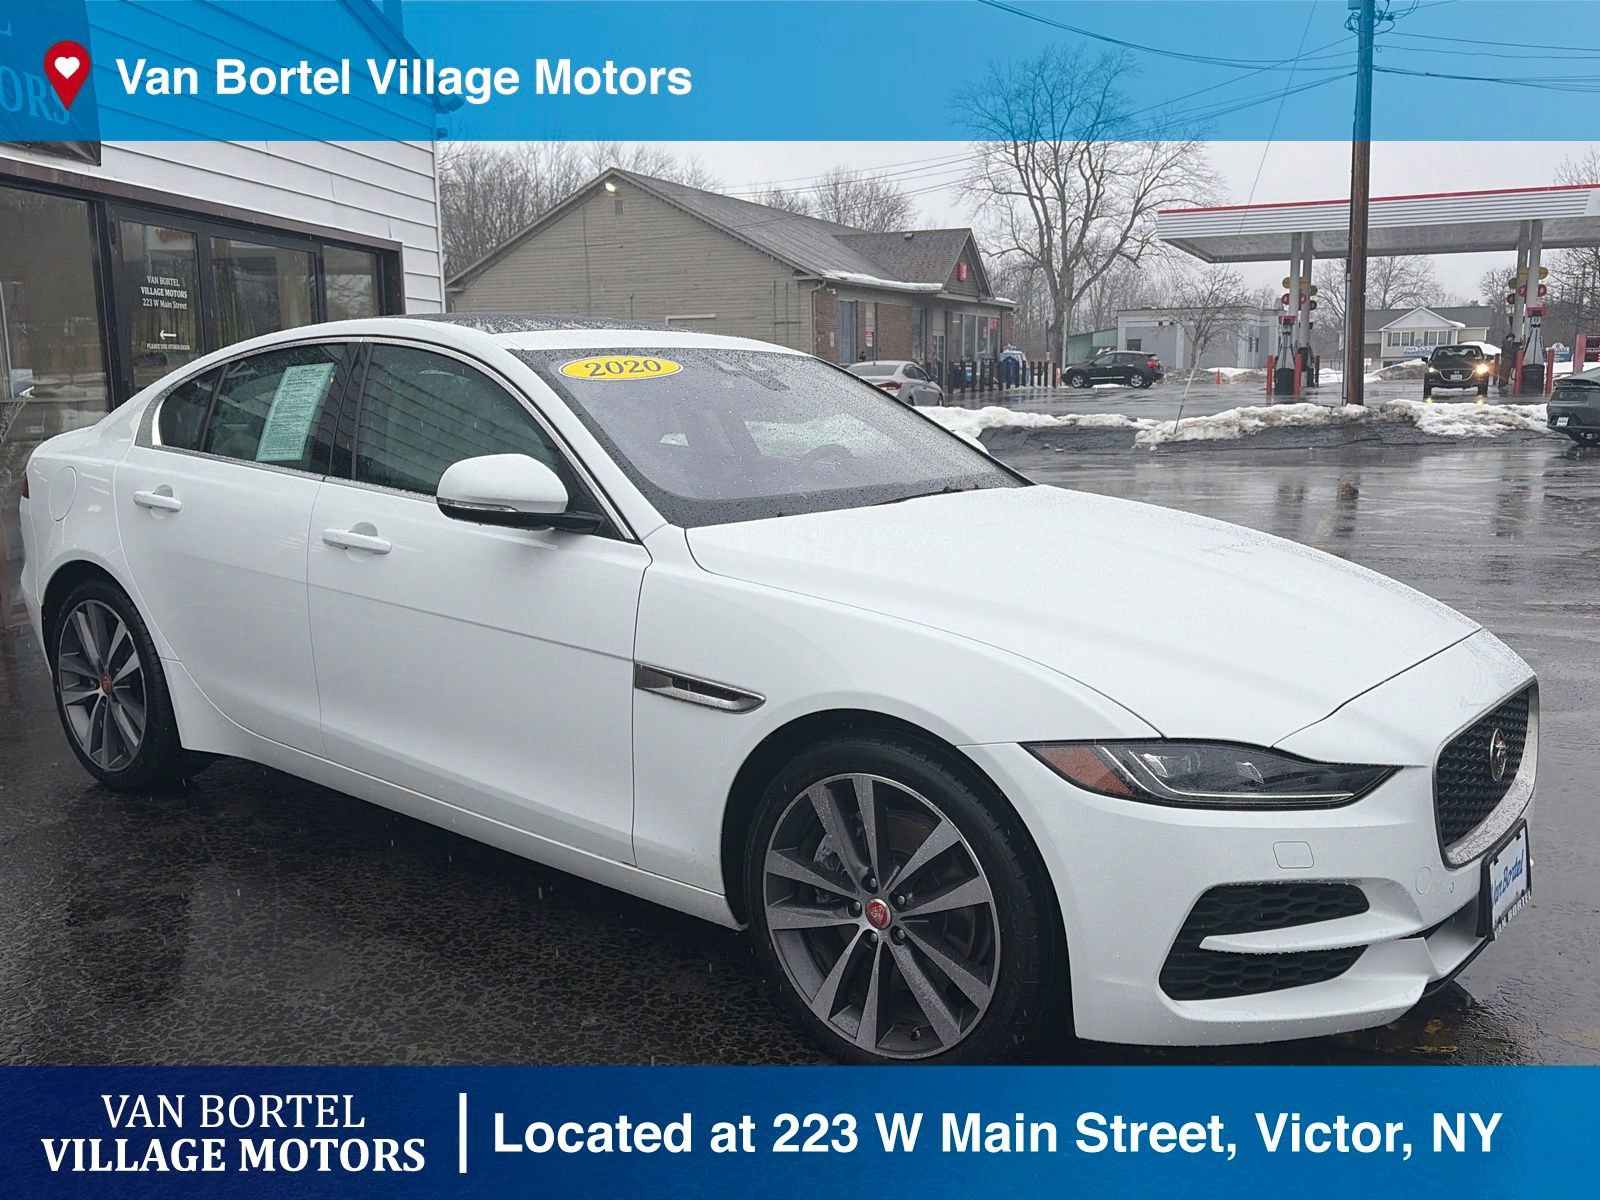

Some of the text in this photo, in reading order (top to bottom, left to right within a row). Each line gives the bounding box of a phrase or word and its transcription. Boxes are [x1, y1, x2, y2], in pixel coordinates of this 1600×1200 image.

[146, 275, 180, 287] VAN BORTEL
[140, 286, 188, 299] VILLAGE MOTORS
[142, 298, 188, 310] 223 W Main Street
[584, 358, 663, 378] 2020
[1502, 848, 1525, 894] Bortel
[1508, 889, 1532, 922] BORTEL
